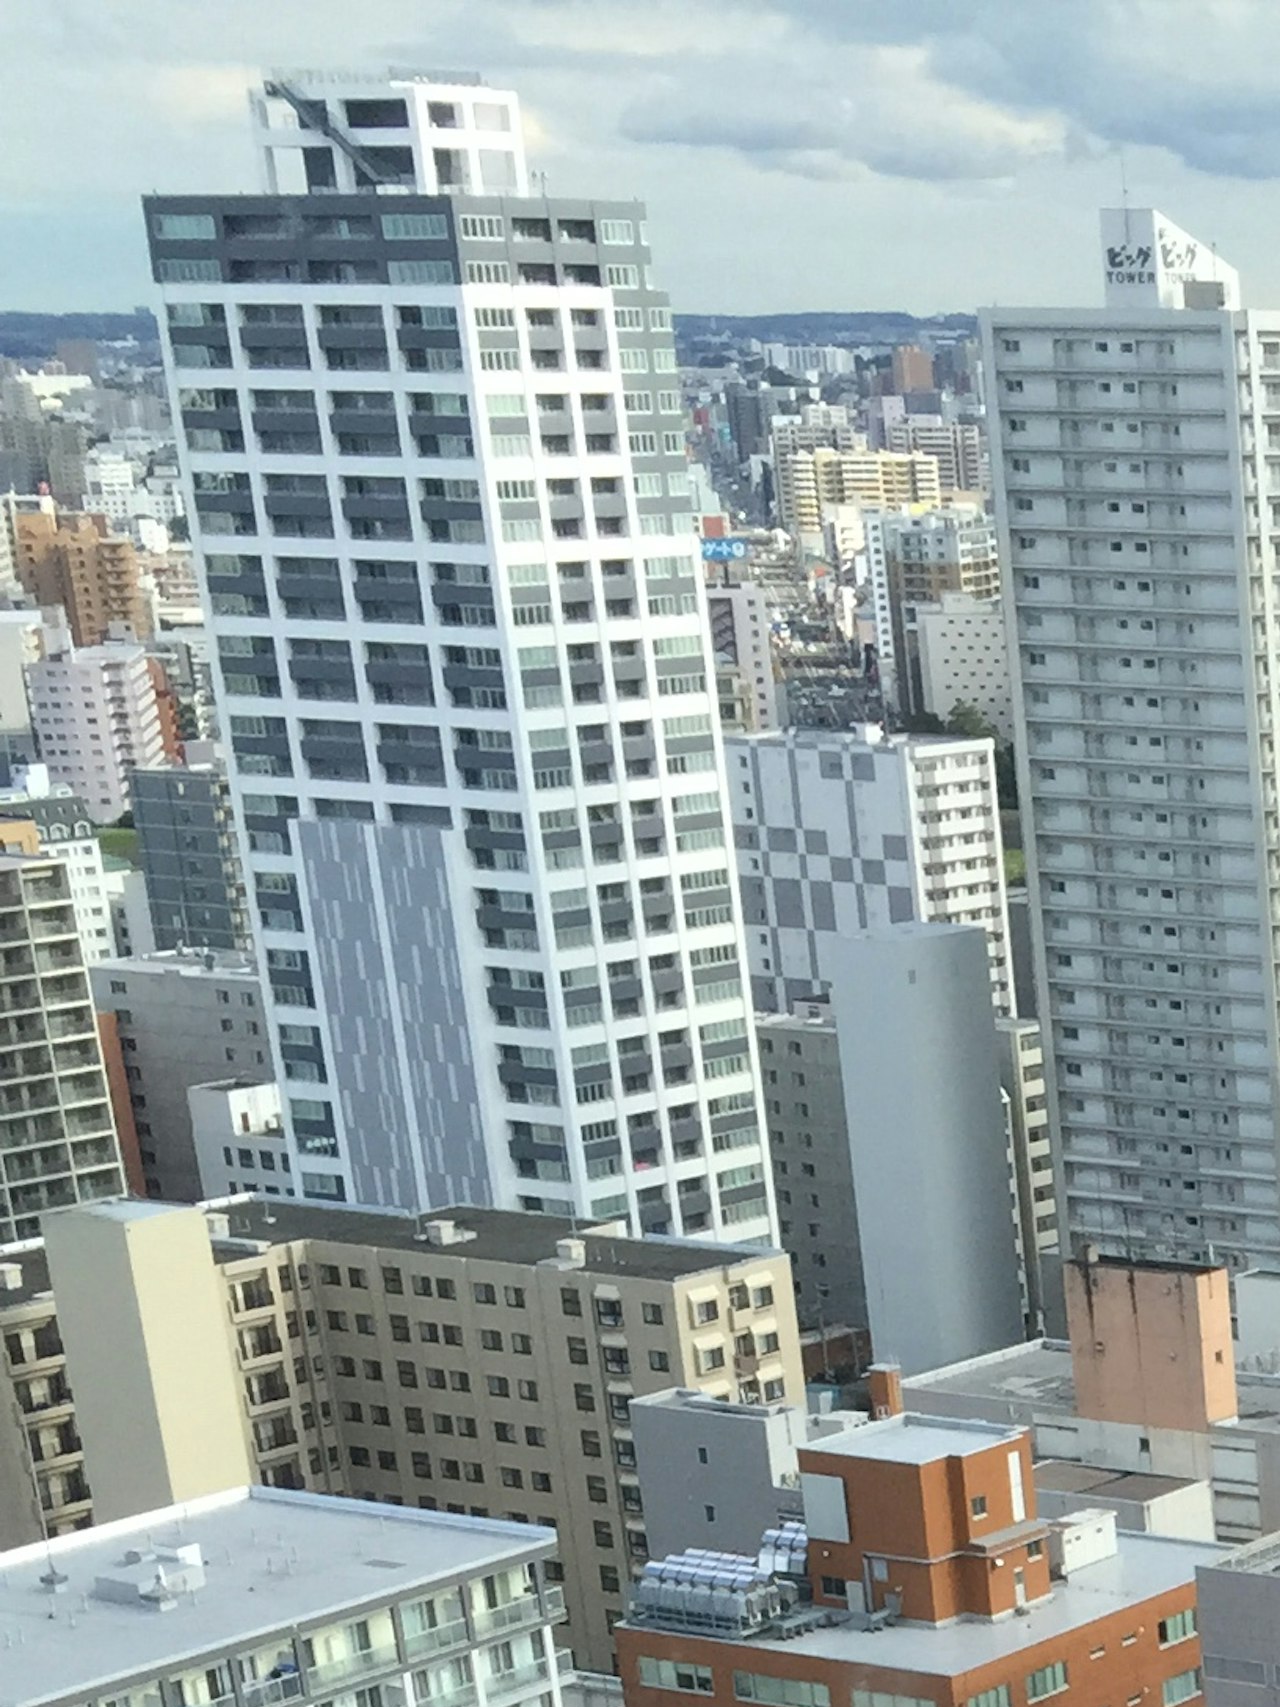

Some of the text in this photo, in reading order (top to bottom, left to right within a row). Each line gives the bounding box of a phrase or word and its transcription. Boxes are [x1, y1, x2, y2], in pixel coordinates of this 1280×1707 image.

[1106, 244, 1152, 268] ビッグ
[1160, 240, 1197, 269] ビッグ
[1106, 271, 1155, 283] TOWER
